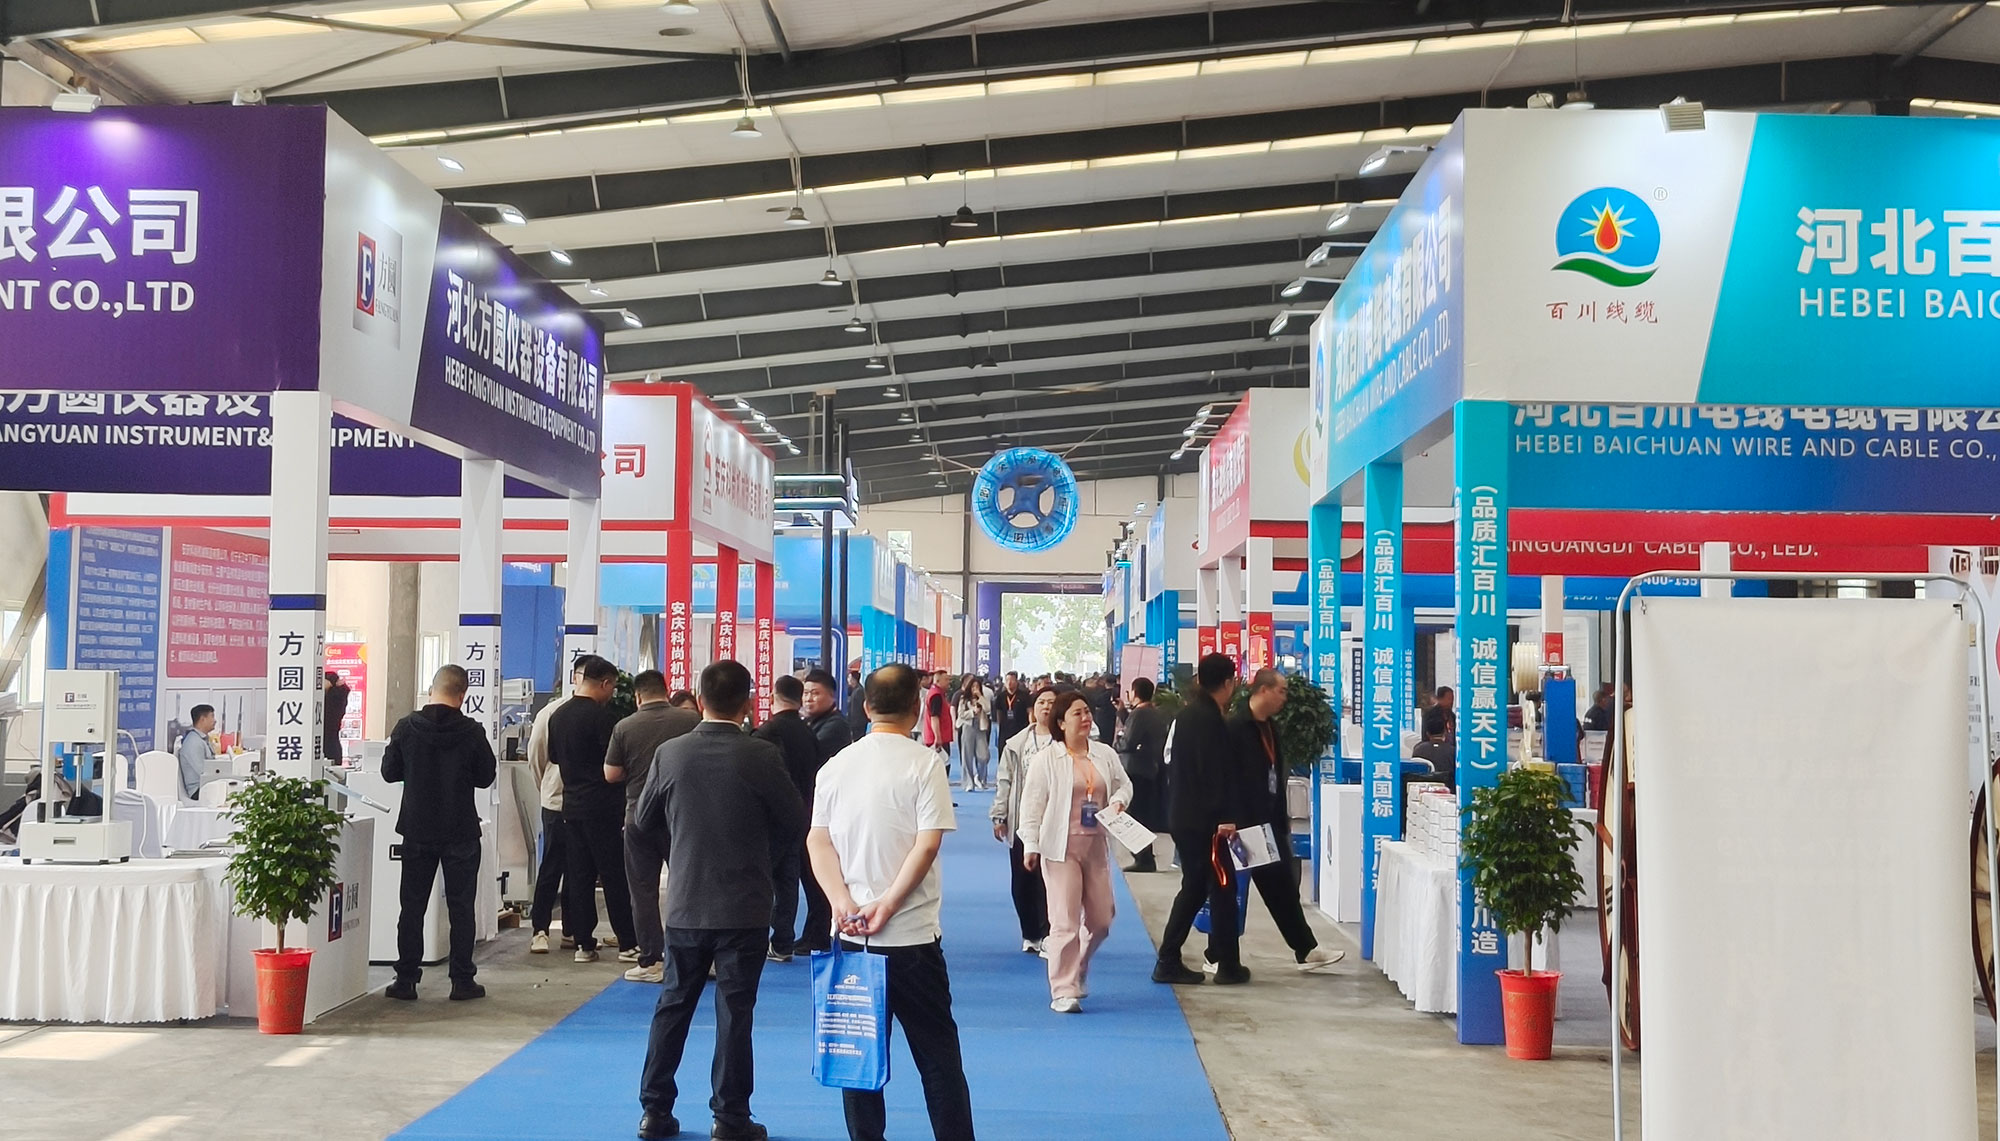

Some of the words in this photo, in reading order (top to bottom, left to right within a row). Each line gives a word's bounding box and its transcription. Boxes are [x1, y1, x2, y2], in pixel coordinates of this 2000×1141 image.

[1796, 206, 2000, 277] 河北百
[50, 280, 195, 318] CO.,LTD
[1545, 300, 1658, 324] 百川线缆
[1800, 287, 1905, 318] HEBEI
[446, 268, 598, 419] 河北方圆仪器设备有限公司
[444, 355, 468, 391] HEBEI
[468, 367, 504, 410] FANGYUAN
[1515, 434, 1582, 453] HEBEI
[1594, 435, 1721, 456] BAICHUAN
[1732, 436, 1791, 457] WIRE
[1802, 437, 1855, 458] AND
[1865, 438, 1939, 459] CABLE
[670, 601, 686, 698] 安庆科尚机械
[277, 631, 305, 760] 方圆仪器
